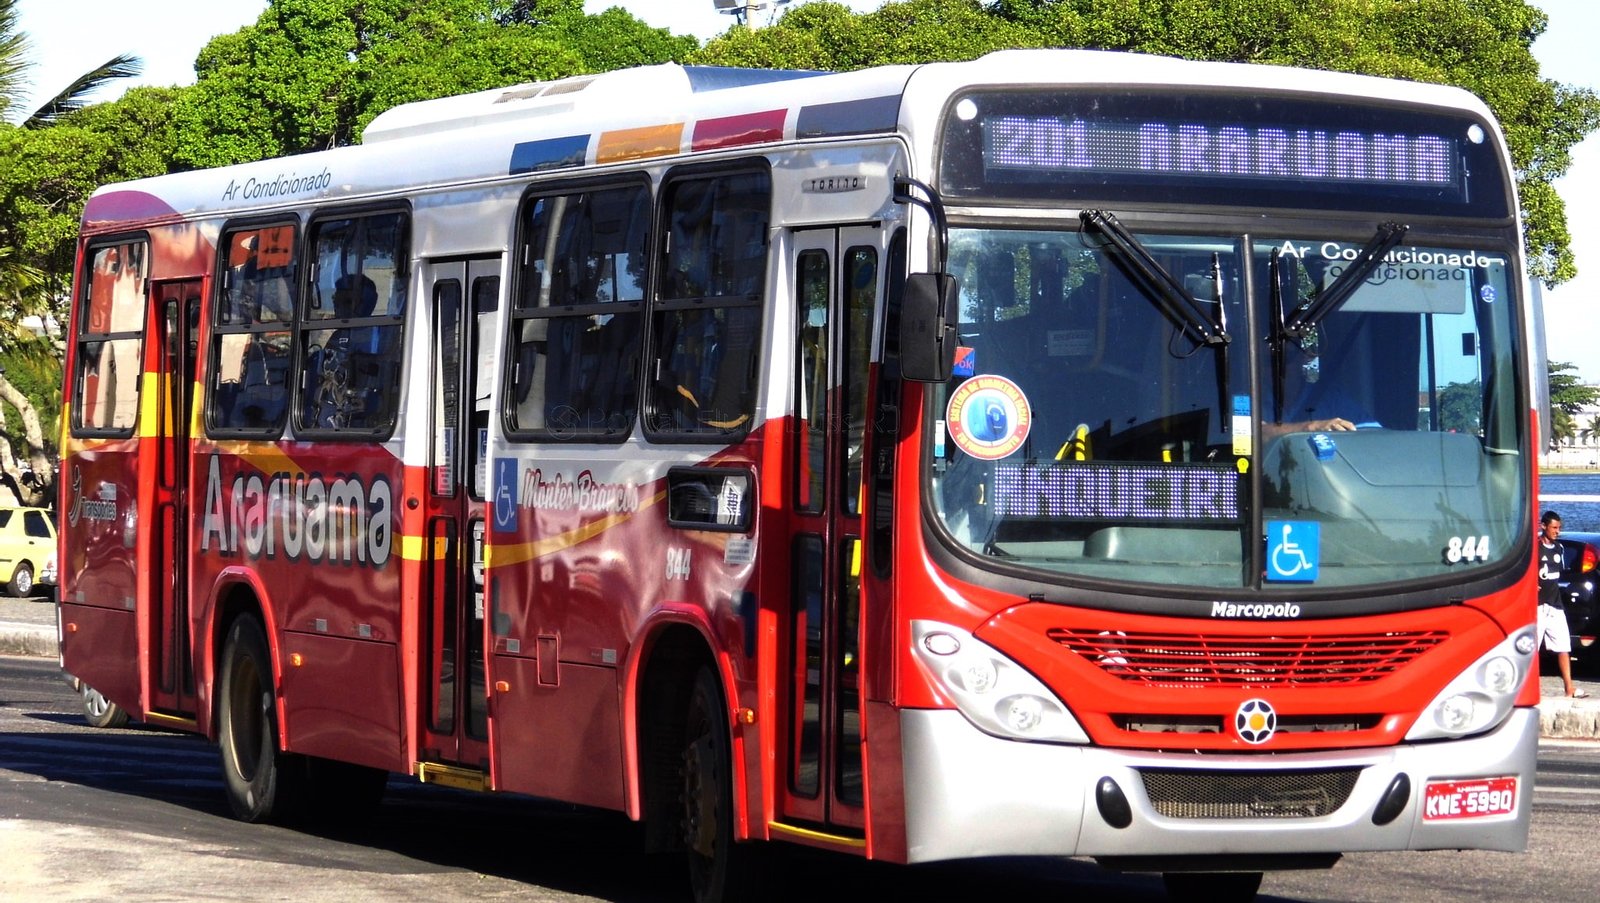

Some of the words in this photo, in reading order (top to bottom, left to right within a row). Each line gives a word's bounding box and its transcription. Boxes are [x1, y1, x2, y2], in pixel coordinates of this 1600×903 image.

[1000, 117, 1092, 168] 201
[1139, 123, 1446, 182] ARARUAMA
[222, 180, 240, 201] Ar
[243, 167, 331, 200] Condicionado
[811, 176, 858, 192] TORINO
[1278, 240, 1311, 259] Ar
[1320, 242, 1491, 268] Coicionado
[202, 450, 392, 565] Araruama
[665, 547, 692, 581] 844
[1447, 535, 1490, 563] 844
[1211, 601, 1300, 619] Marcopolo
